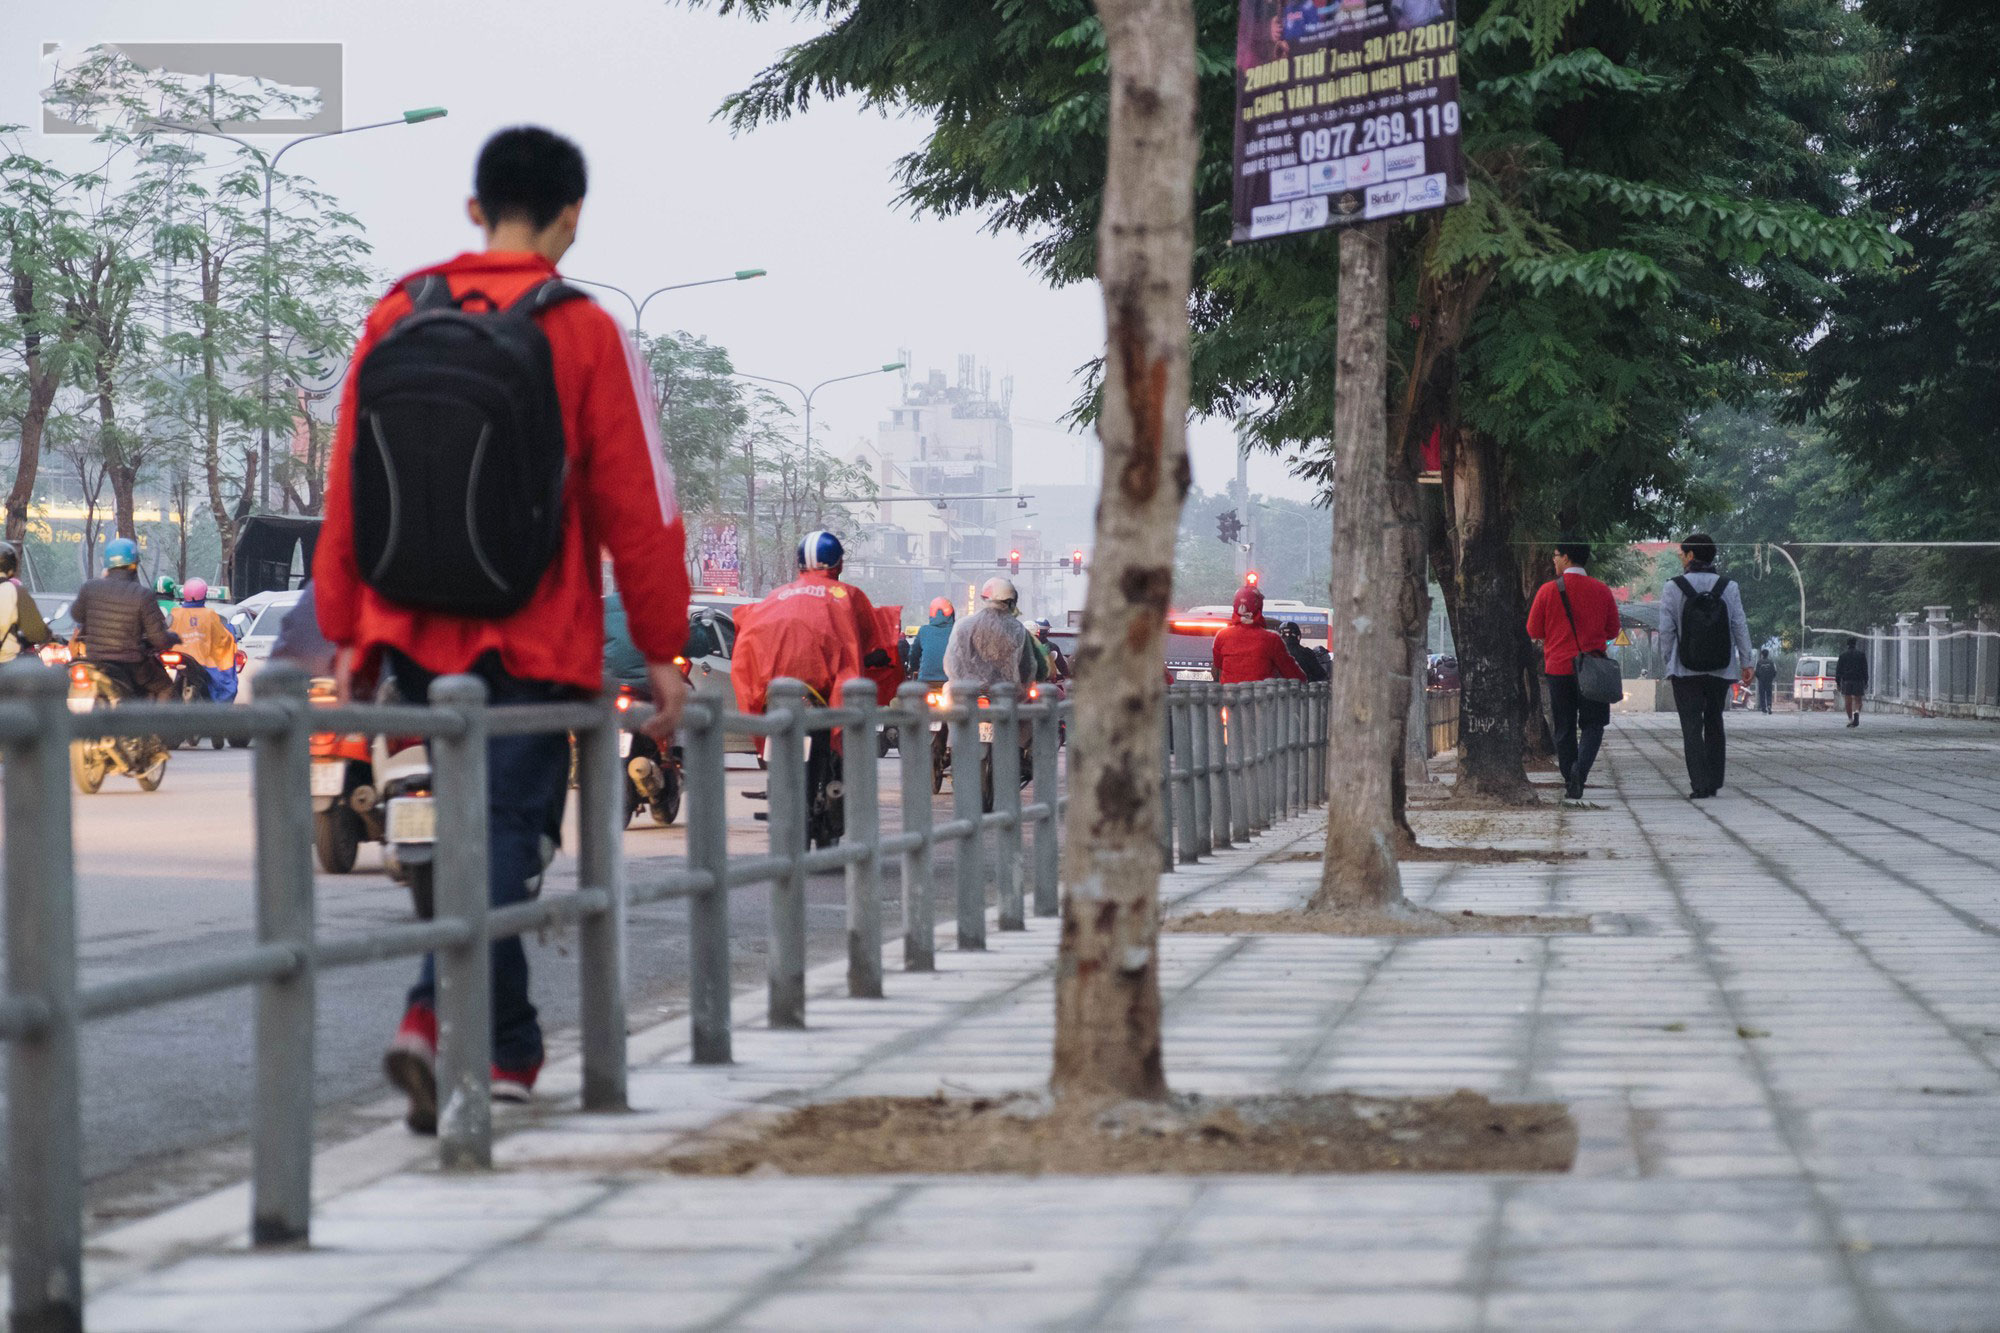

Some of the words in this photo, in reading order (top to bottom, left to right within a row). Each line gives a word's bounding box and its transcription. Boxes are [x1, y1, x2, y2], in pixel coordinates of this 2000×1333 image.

[1364, 20, 1455, 65] 30/12/2017
[1254, 90, 1284, 118] CUNG
[1370, 64, 1402, 92] NGHỊ
[1404, 56, 1435, 86] VIỆT
[1439, 50, 1457, 78] XÔ
[1300, 101, 1459, 163] 0977.269.119
